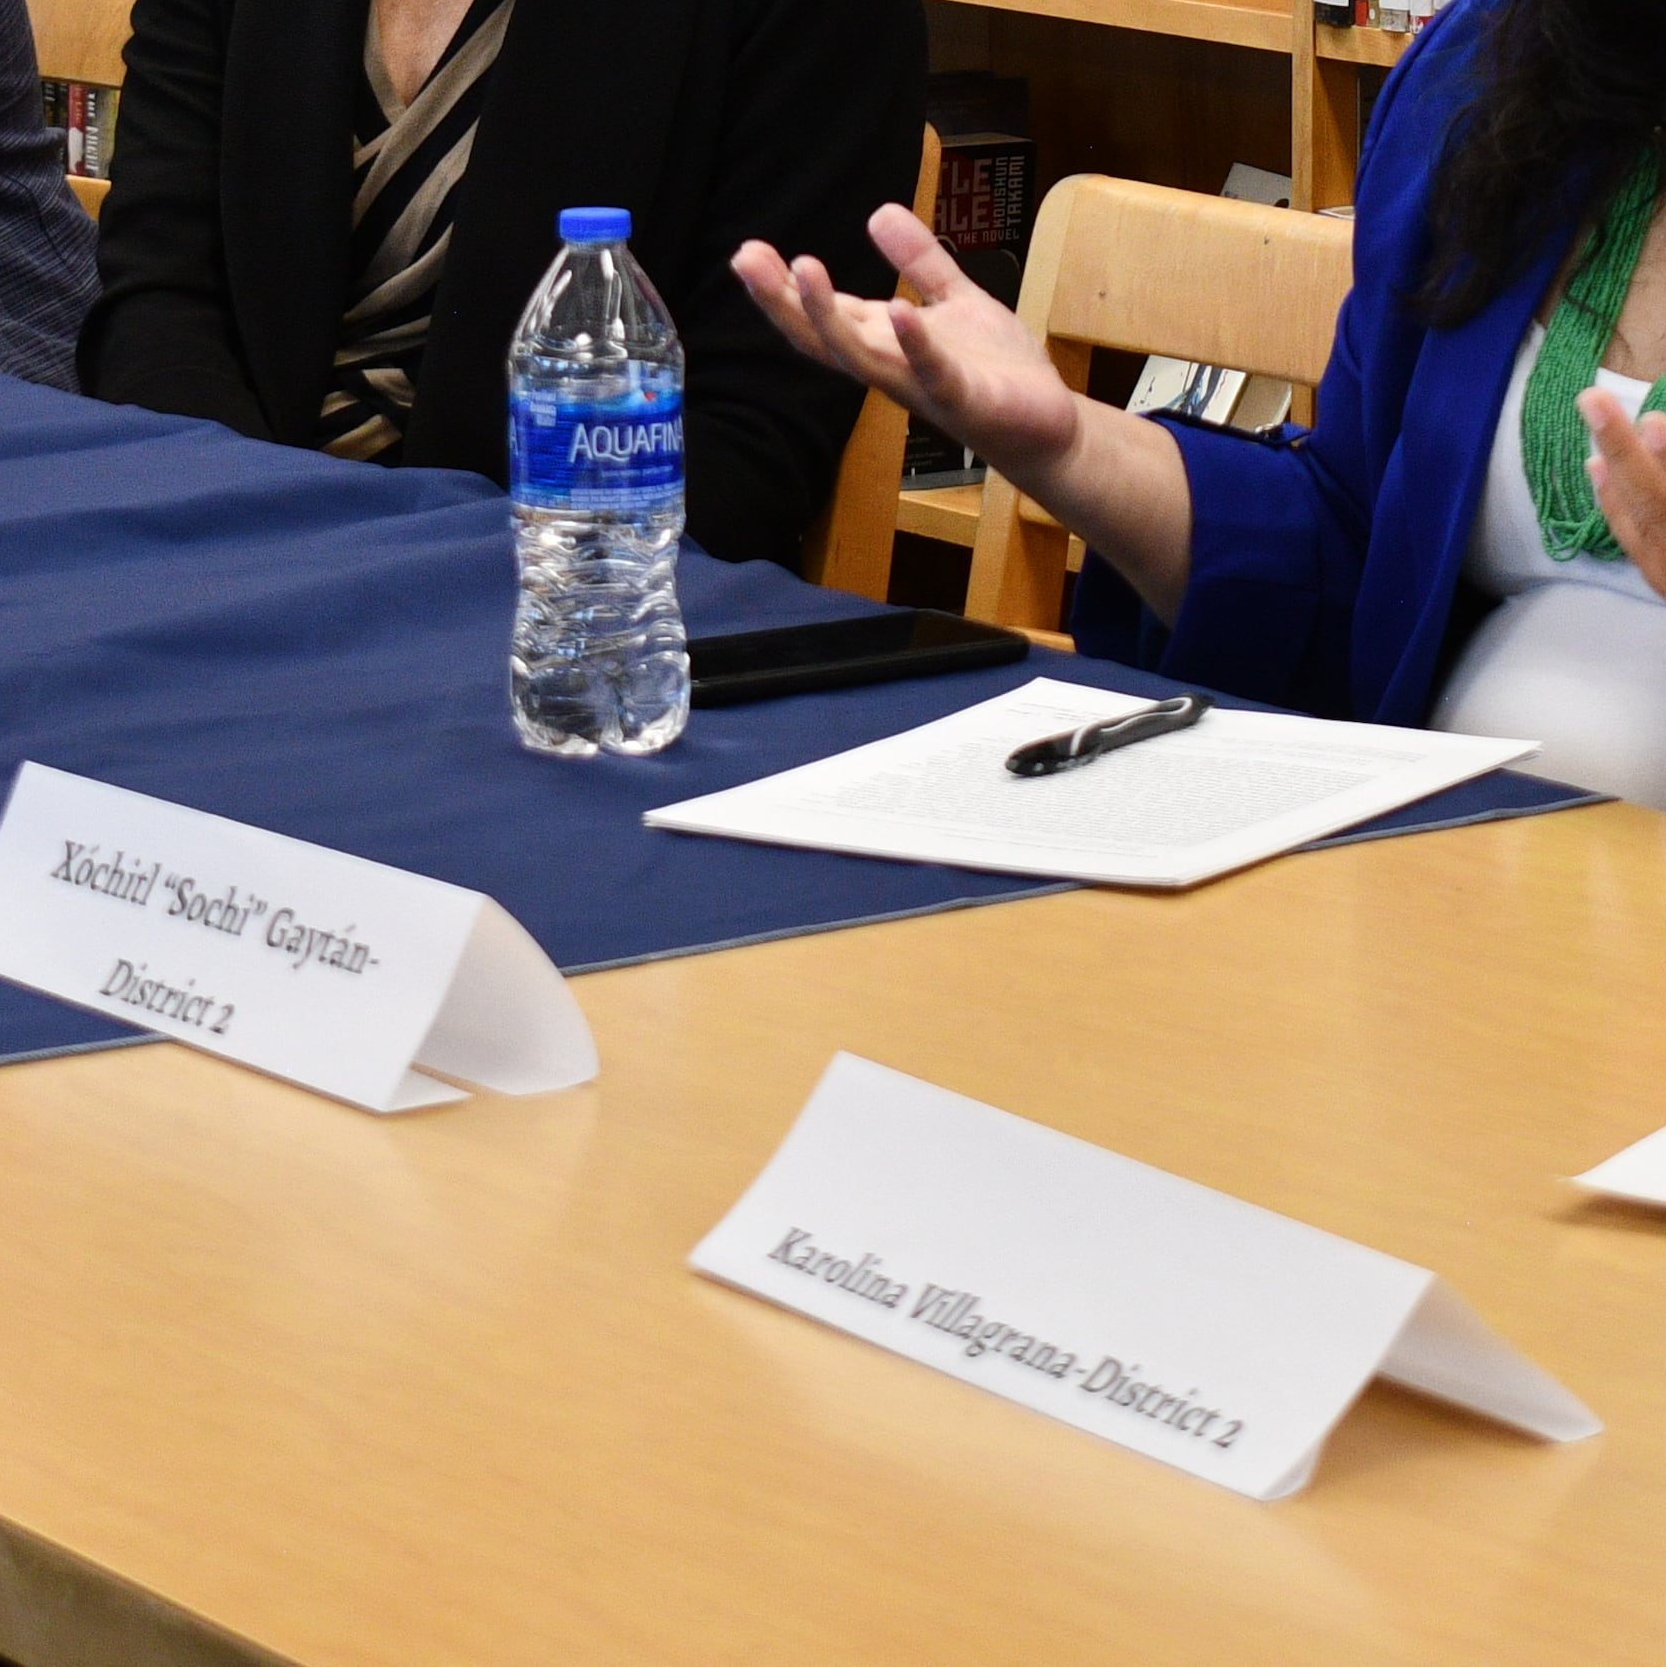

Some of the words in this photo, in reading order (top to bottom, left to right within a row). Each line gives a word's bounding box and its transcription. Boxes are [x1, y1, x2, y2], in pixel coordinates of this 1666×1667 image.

[994, 156, 1008, 230] KOUSHUN
[1007, 154, 1025, 231] TAKAMI
[956, 230, 979, 245] THE
[981, 227, 1021, 243] NOVEL
[52, 840, 161, 907] Xóchitl
[265, 906, 381, 976] Gaytán-
[99, 958, 213, 1030] District
[212, 1004, 236, 1034] 2
[766, 1226, 907, 1310] Karolina
[1215, 1419, 1246, 1450] 2
